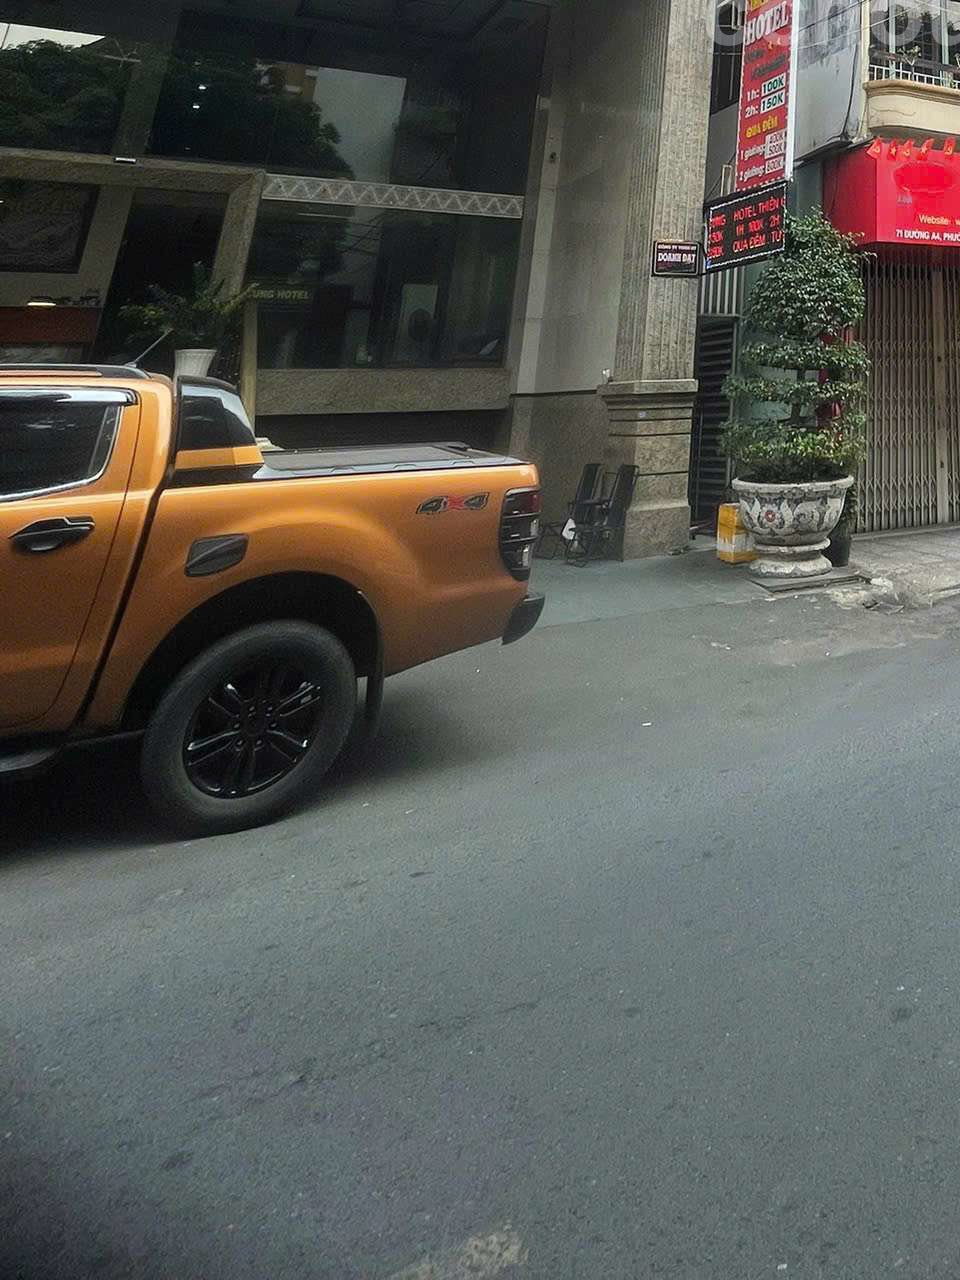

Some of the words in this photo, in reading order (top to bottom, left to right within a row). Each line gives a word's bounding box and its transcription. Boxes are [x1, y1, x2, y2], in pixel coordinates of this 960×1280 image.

[745, 0, 789, 46] HOTEL
[763, 76, 785, 95] 100K
[745, 105, 760, 119] 2h:
[761, 92, 785, 112] 150K
[733, 205, 758, 222] HOTEL
[277, 288, 309, 300] HOTEL
